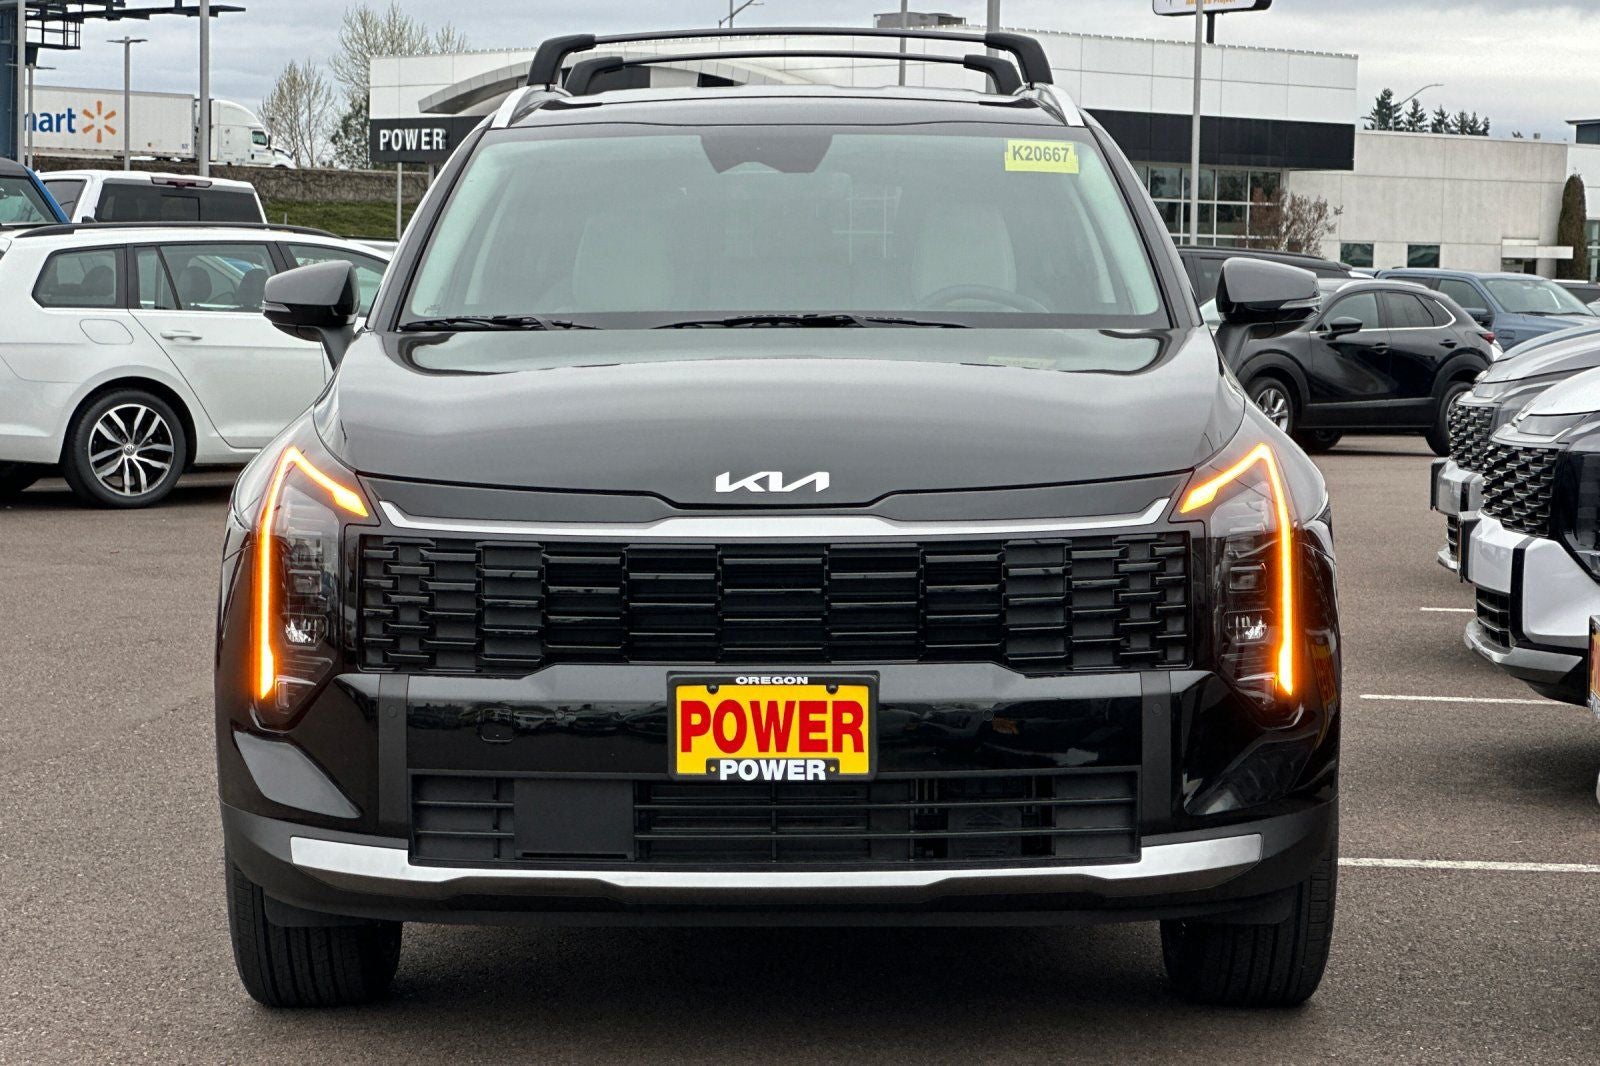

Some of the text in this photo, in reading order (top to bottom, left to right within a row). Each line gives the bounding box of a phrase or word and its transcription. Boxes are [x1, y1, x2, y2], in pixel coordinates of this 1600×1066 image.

[379, 128, 446, 151] POWER
[1012, 145, 1070, 162] K20667
[715, 471, 830, 493] KIA
[735, 676, 809, 685] OREGON
[680, 699, 865, 754] POWER
[719, 759, 826, 781] POWER
